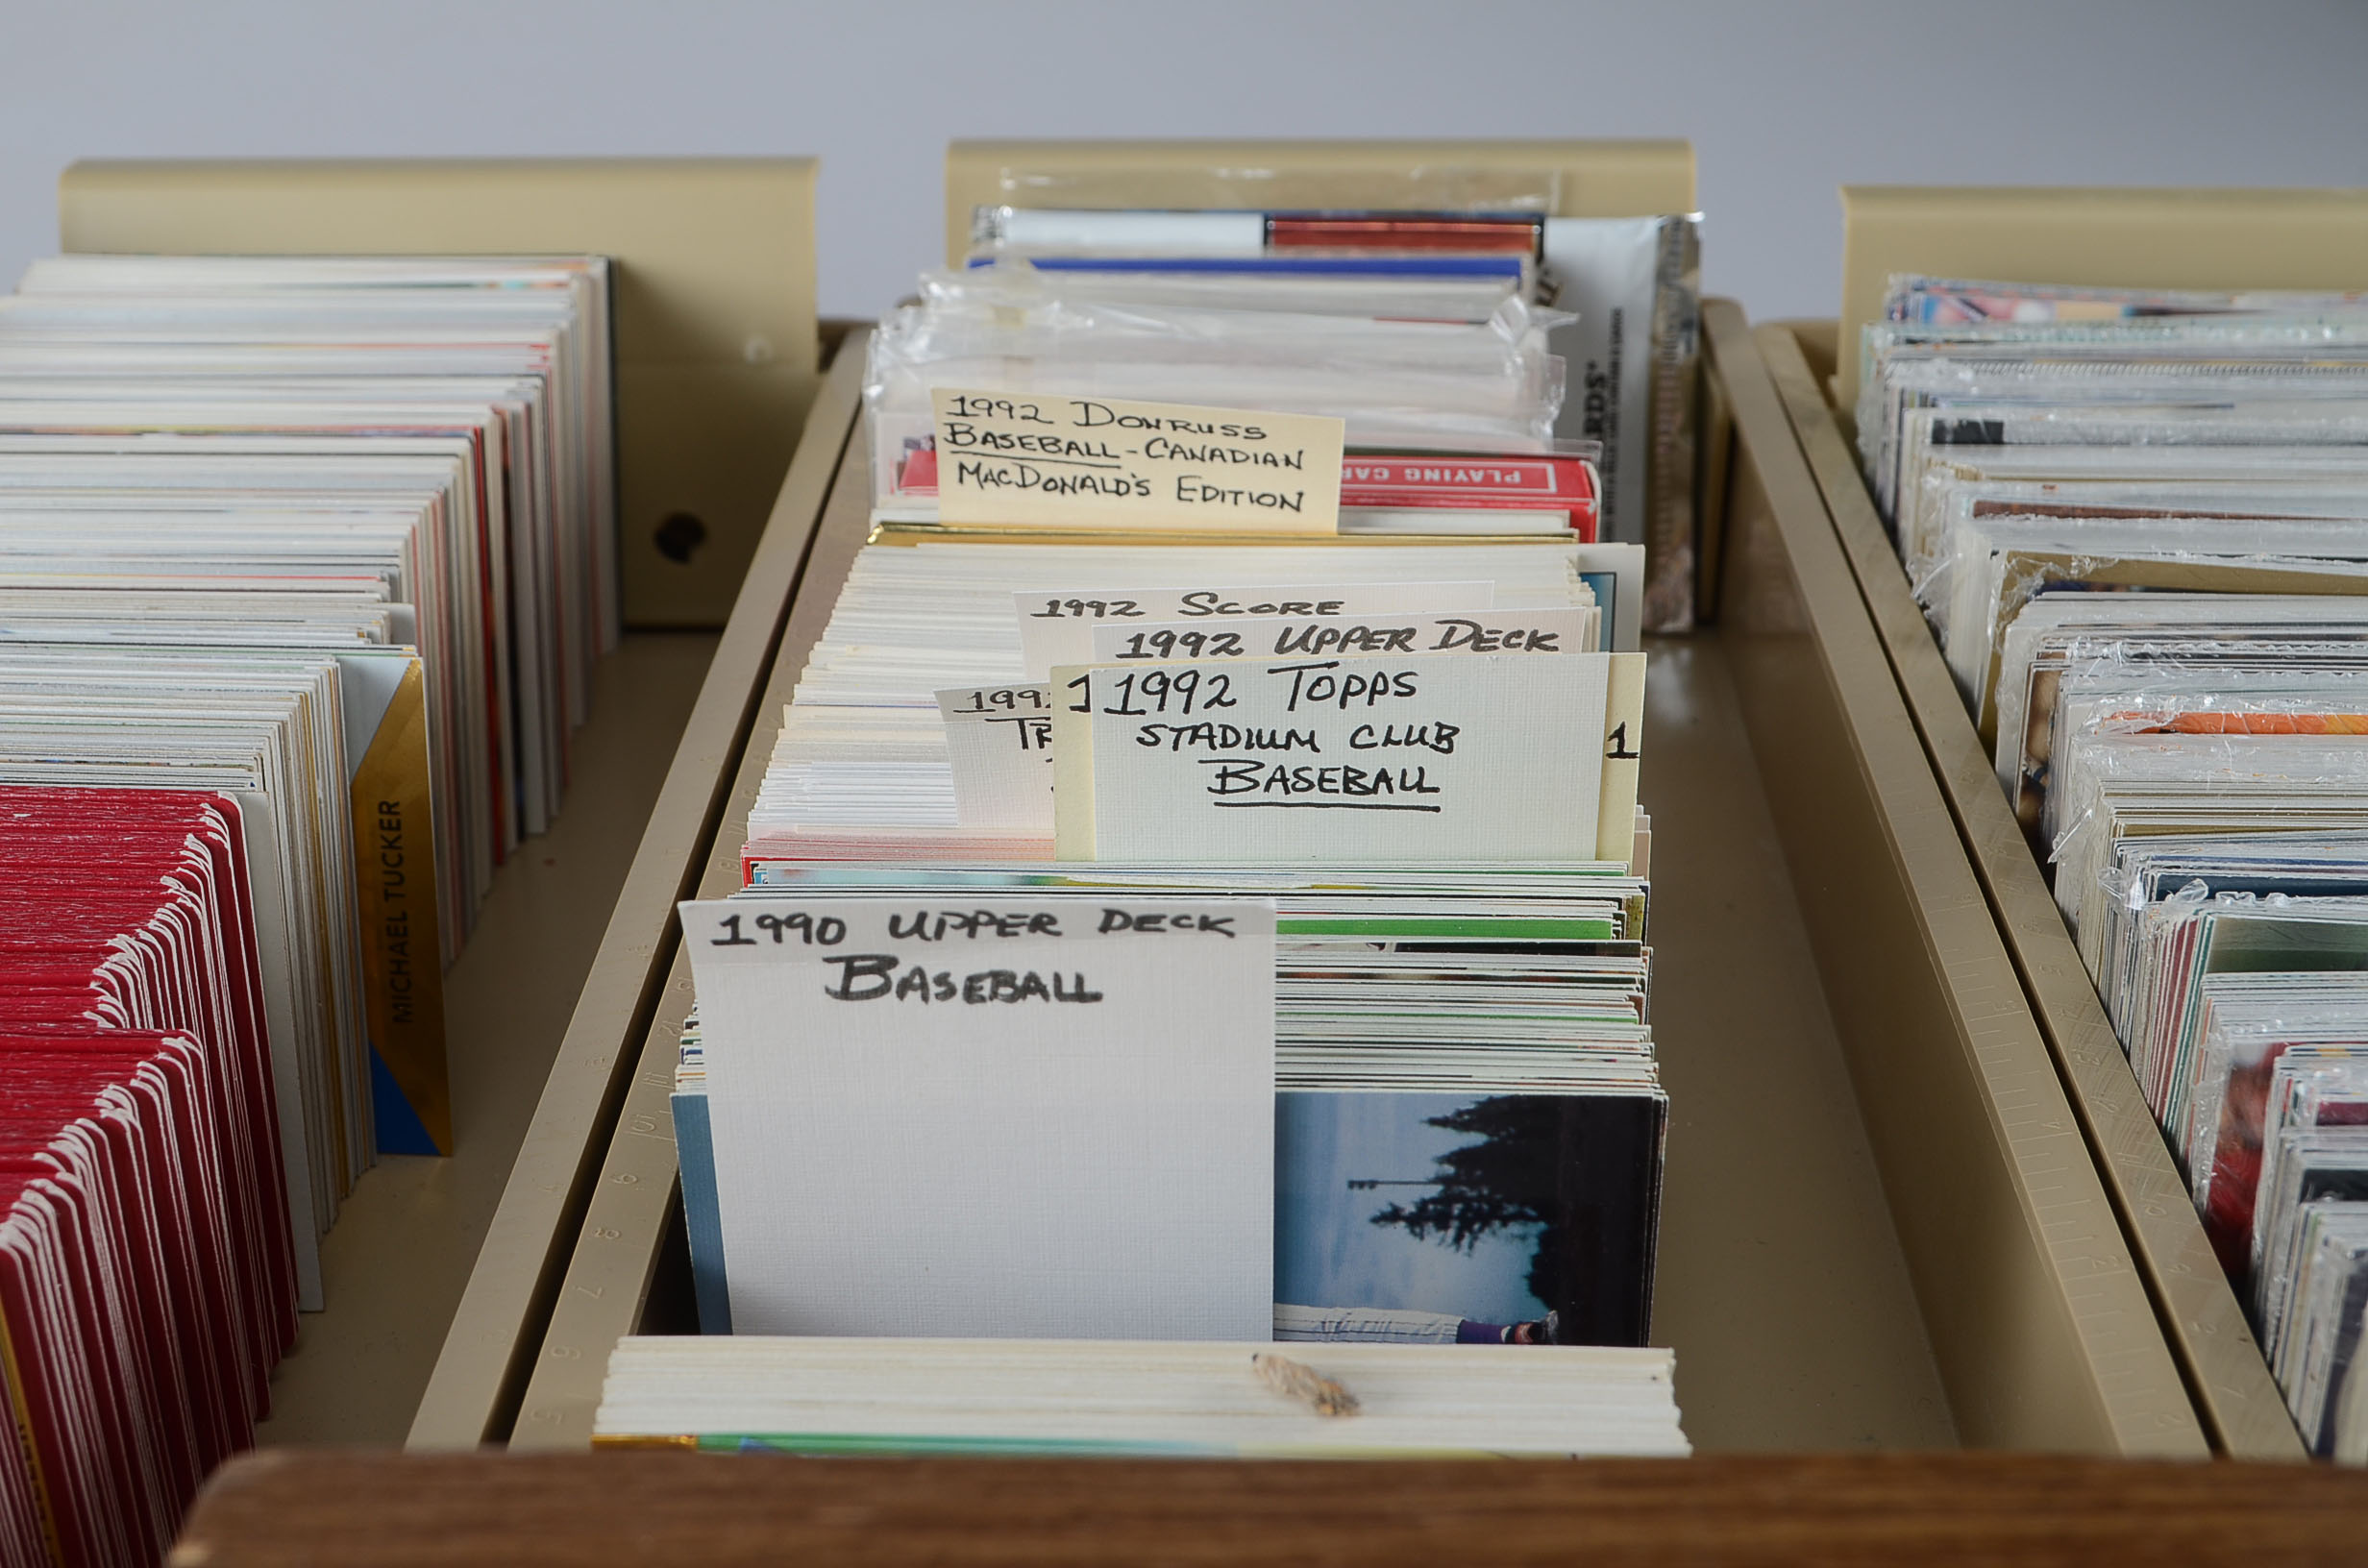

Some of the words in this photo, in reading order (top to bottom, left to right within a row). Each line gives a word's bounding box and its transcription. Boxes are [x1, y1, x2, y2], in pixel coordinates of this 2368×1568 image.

[948, 395, 1054, 424] 1992
[1071, 401, 1268, 441] DONRUSS
[1176, 476, 1304, 513] EDITION
[1404, 469, 1521, 483] PLAYING
[1029, 599, 1146, 618] 1992
[1177, 591, 1345, 617] SCORE
[1115, 629, 1245, 658] 1992
[1273, 624, 1418, 655] UPPER
[1428, 619, 1562, 653] DECK
[952, 689, 1051, 714] 199
[1103, 670, 1237, 716] 1992
[1267, 661, 1418, 712] TOPPS
[1135, 722, 1321, 753] STADIUM
[1349, 721, 1461, 755] CLUB
[1197, 758, 1442, 796] BASEBALL
[378, 799, 406, 902] TUCKER
[710, 913, 848, 946] 1990
[888, 910, 1063, 942] UPPER
[1098, 908, 1237, 939] DECK
[384, 910, 413, 1024] MICHAEL
[822, 954, 1104, 1005] BASEBALL
